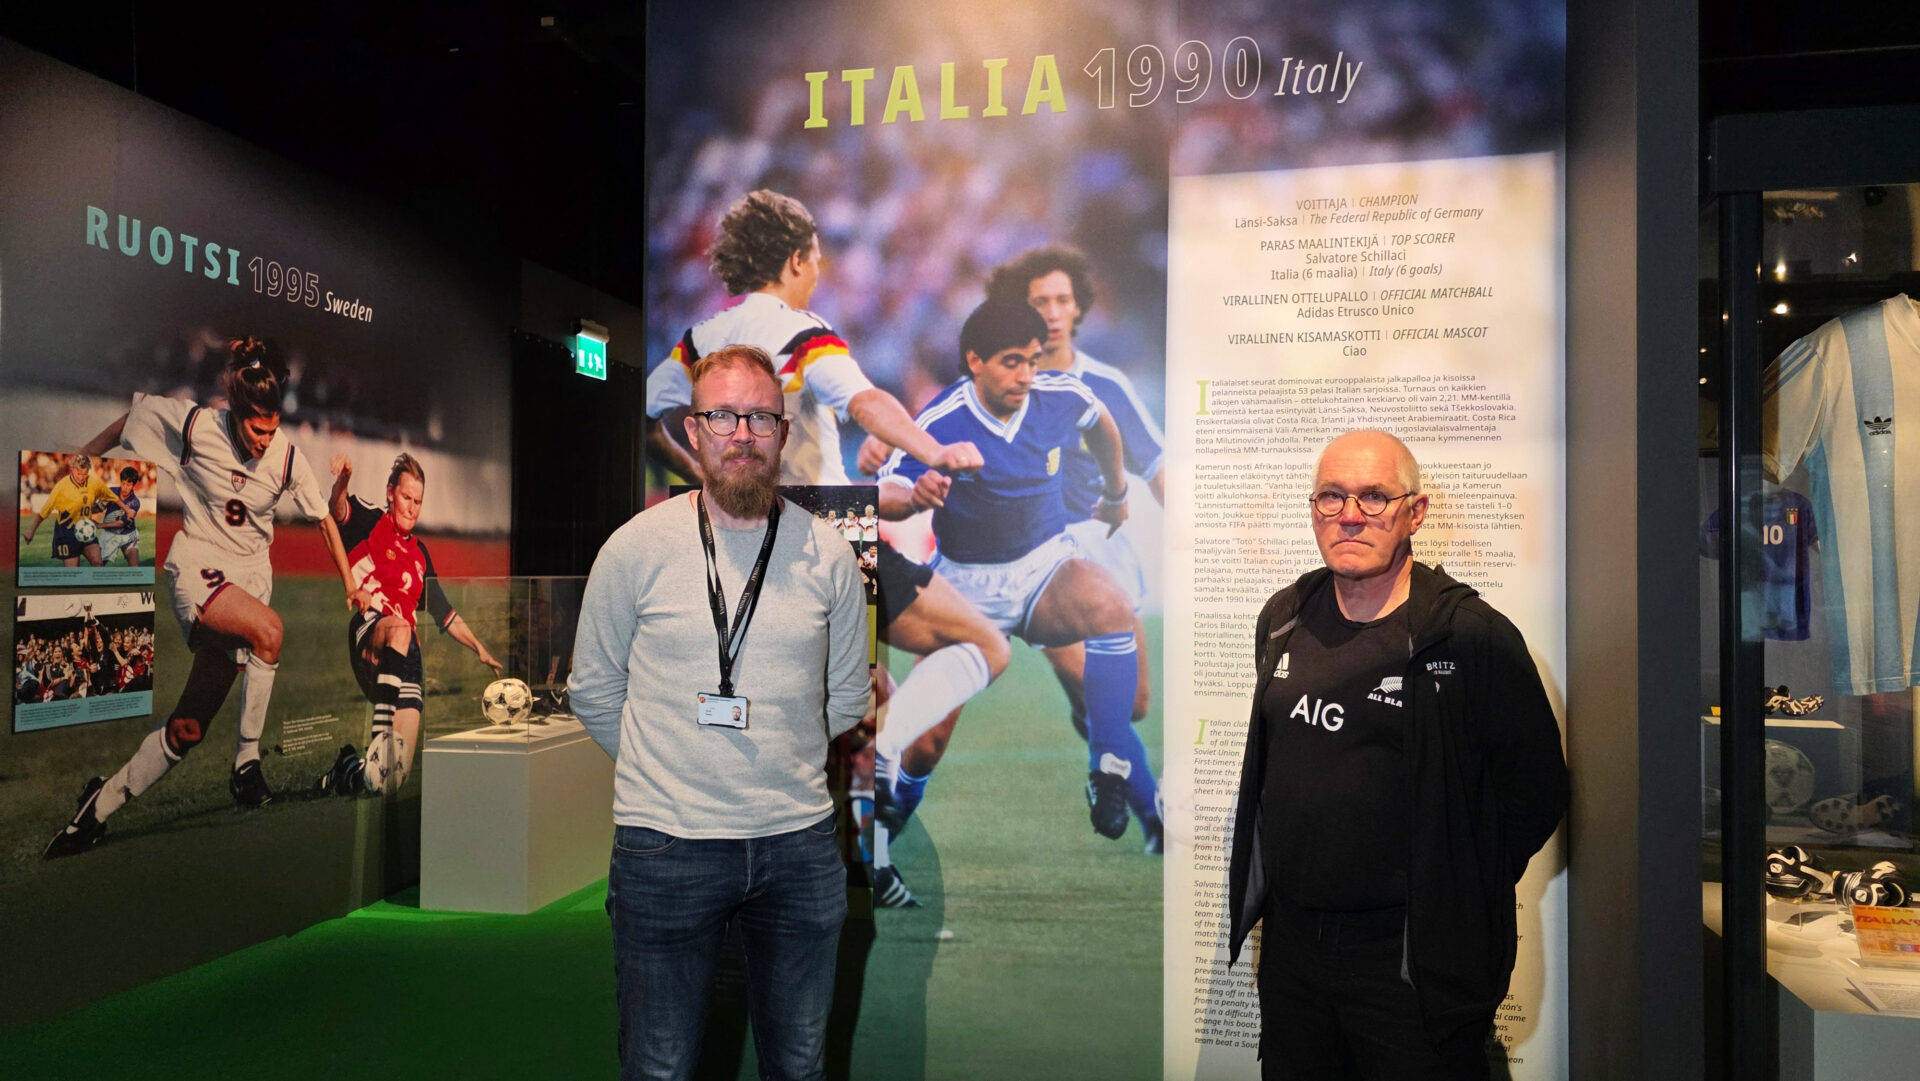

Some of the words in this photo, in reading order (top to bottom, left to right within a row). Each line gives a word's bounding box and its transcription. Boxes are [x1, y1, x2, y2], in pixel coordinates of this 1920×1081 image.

[804, 54, 1068, 128] ITALIA
[1083, 36, 1262, 109] 1990
[1274, 51, 1363, 104] Italy
[1296, 196, 1347, 213] VOITTAJA
[1359, 193, 1418, 207] CHAMPION
[1235, 214, 1297, 227] Länsi-Saksa
[1310, 212, 1327, 224] The
[1329, 210, 1370, 223] Federal
[1371, 208, 1417, 224] Republic
[1420, 207, 1432, 222] of
[1433, 205, 1484, 221] Germany
[1260, 238, 1294, 250] PARAS
[1298, 232, 1378, 252] MAALINTEKIJÄ
[1391, 233, 1411, 245] TOP
[1413, 231, 1455, 244] SCORER
[1306, 250, 1357, 263] Salvatore
[1360, 248, 1405, 261] Schillaci
[86, 205, 240, 286] RUOTSI
[248, 256, 320, 308] 1995
[324, 291, 373, 323] Sweden
[1271, 267, 1298, 279] Italia
[1302, 267, 1312, 281] (6
[1316, 265, 1357, 281] maalia)
[1369, 264, 1394, 279] Italy
[1396, 263, 1407, 278] (6
[1408, 262, 1442, 277] goals)
[1222, 292, 1288, 305] VIRALLINEN
[1291, 290, 1368, 303] OTTELUPALLO
[1380, 287, 1426, 300] OFFICIAL
[1430, 285, 1492, 298] MATCHBALL
[1296, 306, 1334, 318] Adidas
[1337, 304, 1378, 316] Etrusco
[1382, 303, 1414, 315] Unico
[1228, 331, 1293, 344] VIRALLINEN
[1297, 329, 1380, 342] KISAMASKOTTI
[1392, 327, 1439, 339] OFFICIAL
[1442, 326, 1488, 338] MASCOT
[1342, 344, 1366, 356] Ciao
[1324, 376, 1385, 385] eurooppalaista
[1386, 375, 1431, 384] jalkapalloa
[1432, 374, 1440, 383] ja
[1211, 388, 1256, 397] pelanneista
[1258, 387, 1296, 396] pelaajista
[1310, 387, 1333, 396] pelasi
[1211, 398, 1239, 407] aikojen
[1300, 396, 1364, 404] ottelukohtainen
[1419, 394, 1437, 402] vain
[1461, 393, 1510, 401] MM-kentillä
[1275, 406, 1316, 416] esiintyivät
[1347, 416, 1354, 424] ja
[1356, 415, 1405, 424] Yhdistyneet
[1394, 424, 1496, 433] jugoslavialaisvalmentaja
[1438, 434, 1501, 443] kymmenennen
[1195, 446, 1241, 455] nollapelinsä
[1483, 461, 1491, 470] jo
[1430, 472, 1459, 480] yleisön
[225, 498, 247, 527] 9
[1763, 525, 1784, 545] 10
[1291, 538, 1314, 546] pelasi
[1430, 539, 1448, 548] löysi
[57, 544, 69, 556] 10
[398, 571, 412, 595] 2
[1426, 661, 1456, 671] BRITZ
[1367, 692, 1383, 702] ALL
[1384, 695, 1403, 708] BLA
[1289, 694, 1345, 732] AIG
[1194, 804, 1232, 812] Cameroon
[1193, 880, 1228, 888] Salvatore
[1194, 939, 1225, 948] matches
[1195, 956, 1207, 964] The
[1194, 966, 1225, 977] previous
[1194, 976, 1234, 988] historically
[1236, 980, 1254, 988] their
[1194, 986, 1223, 997] sending
[1225, 989, 1236, 998] off
[1246, 990, 1258, 998] the
[1193, 996, 1212, 1006] from
[1220, 998, 1249, 1009] penalty
[1194, 1006, 1207, 1016] put
[1224, 1009, 1253, 1020] difficult
[1194, 1016, 1221, 1027] change
[1236, 1020, 1257, 1028] boots
[1224, 1029, 1240, 1038] first
[1194, 1036, 1213, 1044] team
[1215, 1038, 1232, 1046] beat
